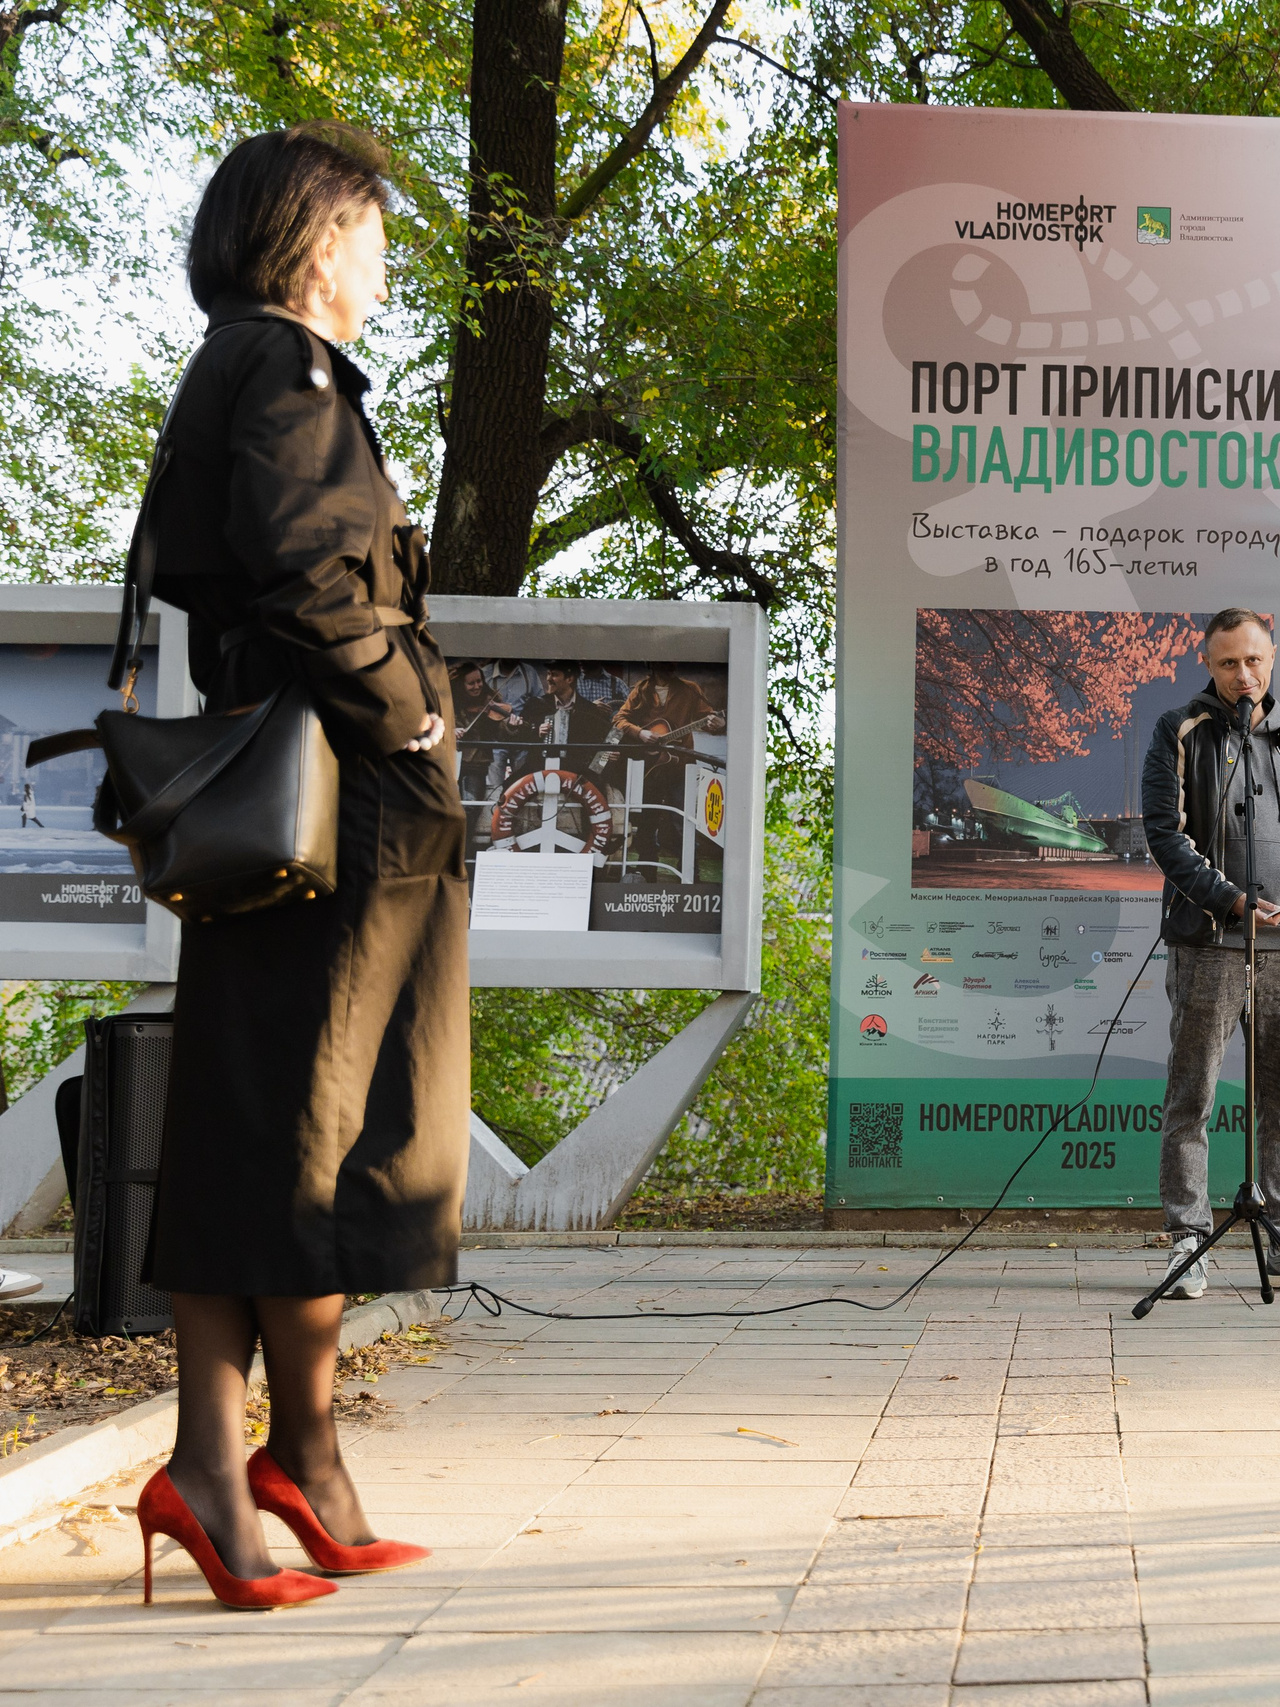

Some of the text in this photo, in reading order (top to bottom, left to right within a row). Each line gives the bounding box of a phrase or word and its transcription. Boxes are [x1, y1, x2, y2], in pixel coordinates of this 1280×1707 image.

[997, 202, 1117, 224] HOMEPORT
[1180, 214, 1244, 223] Администрация
[955, 221, 1104, 243] VLADIVOSTOK
[1180, 234, 1234, 242] Владивостока
[912, 361, 1026, 416] ПОРТ
[912, 513, 1040, 541] Выставка
[1080, 525, 1185, 550] подарок
[985, 548, 1198, 579] в год 165-летия
[61, 884, 120, 894] HOMEPORT
[122, 885, 142, 904] 20
[41, 893, 113, 904] VLADIVOSTOK
[624, 893, 681, 904] HOMEPORT
[683, 894, 720, 913] 2012
[911, 893, 943, 901] Максим
[945, 894, 983, 902] Недосек.
[985, 894, 1047, 903] Мемориальная
[1050, 895, 1103, 903] Гвардейская
[605, 902, 674, 913] VLADIVOSTOK
[977, 1032, 1016, 1040] НАГОРНЫЙ
[1060, 1141, 1116, 1170] 2025
[849, 1156, 903, 1168] ВКОНТАКТЕ
